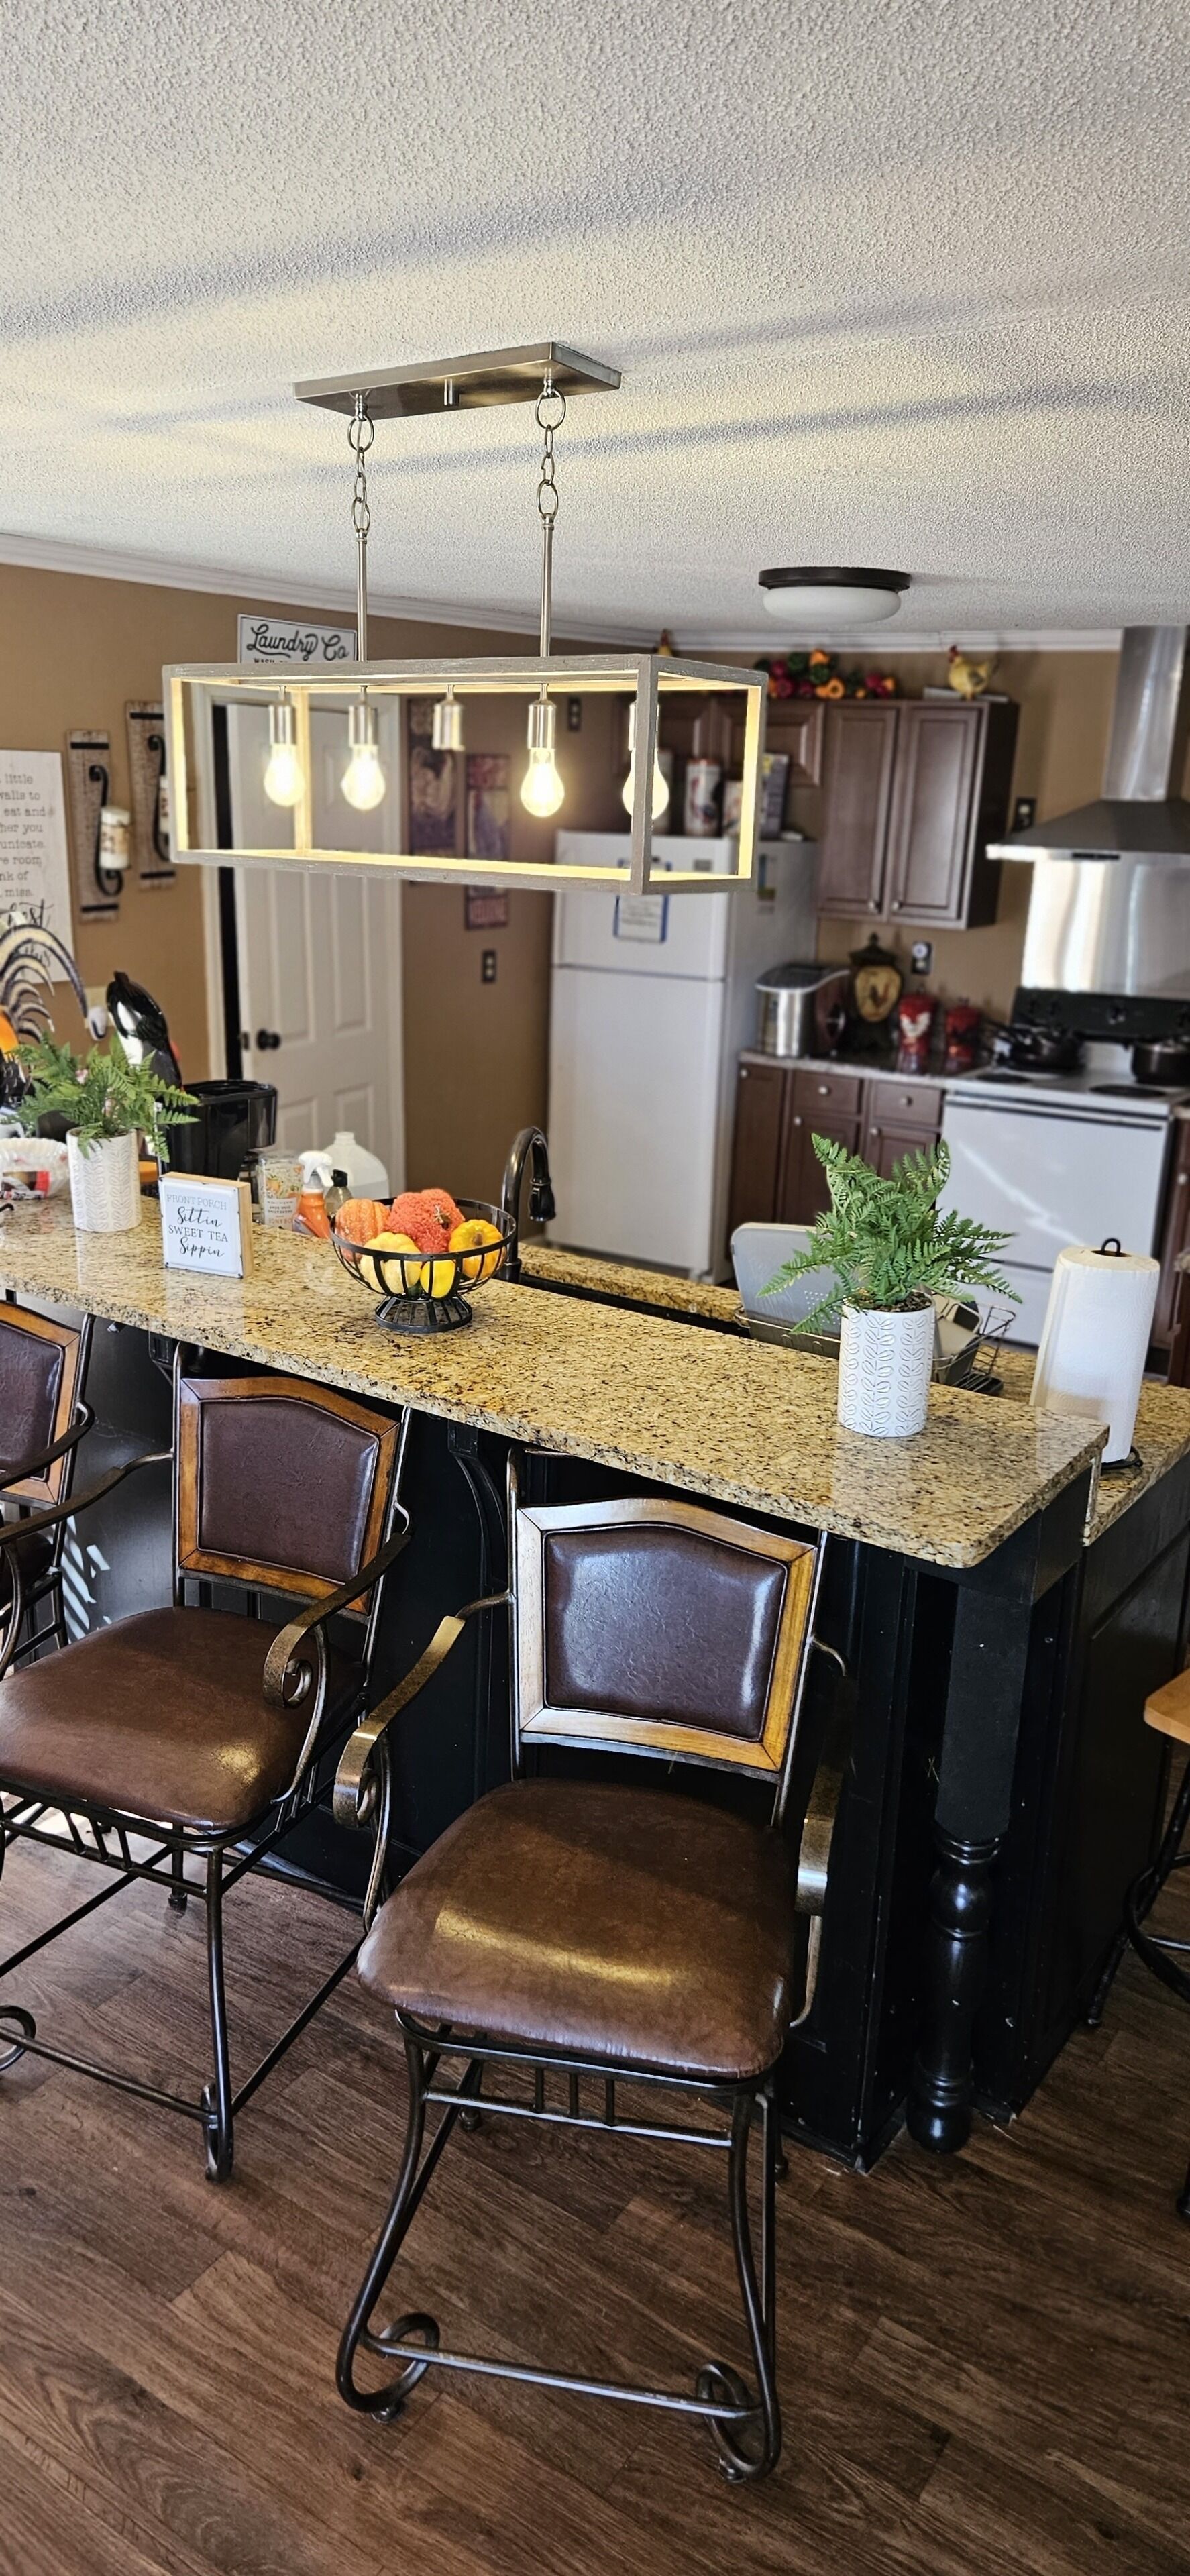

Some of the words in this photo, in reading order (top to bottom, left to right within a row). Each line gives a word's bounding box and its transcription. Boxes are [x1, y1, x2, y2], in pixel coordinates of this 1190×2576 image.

[246, 623, 319, 661] Laundry
[321, 634, 349, 661] Co
[4, 773, 34, 784] little
[29, 792, 41, 800] to
[4, 807, 21, 816] eat
[25, 806, 46, 816] and
[22, 824, 44, 835] you
[17, 871, 29, 881] of
[166, 1194, 196, 1205] FRONT
[197, 1197, 227, 1210] PORCH
[177, 1206, 223, 1227] Sittin
[168, 1224, 203, 1238] SWEET
[207, 1230, 229, 1242] TEA
[180, 1236, 225, 1258] Sippin
